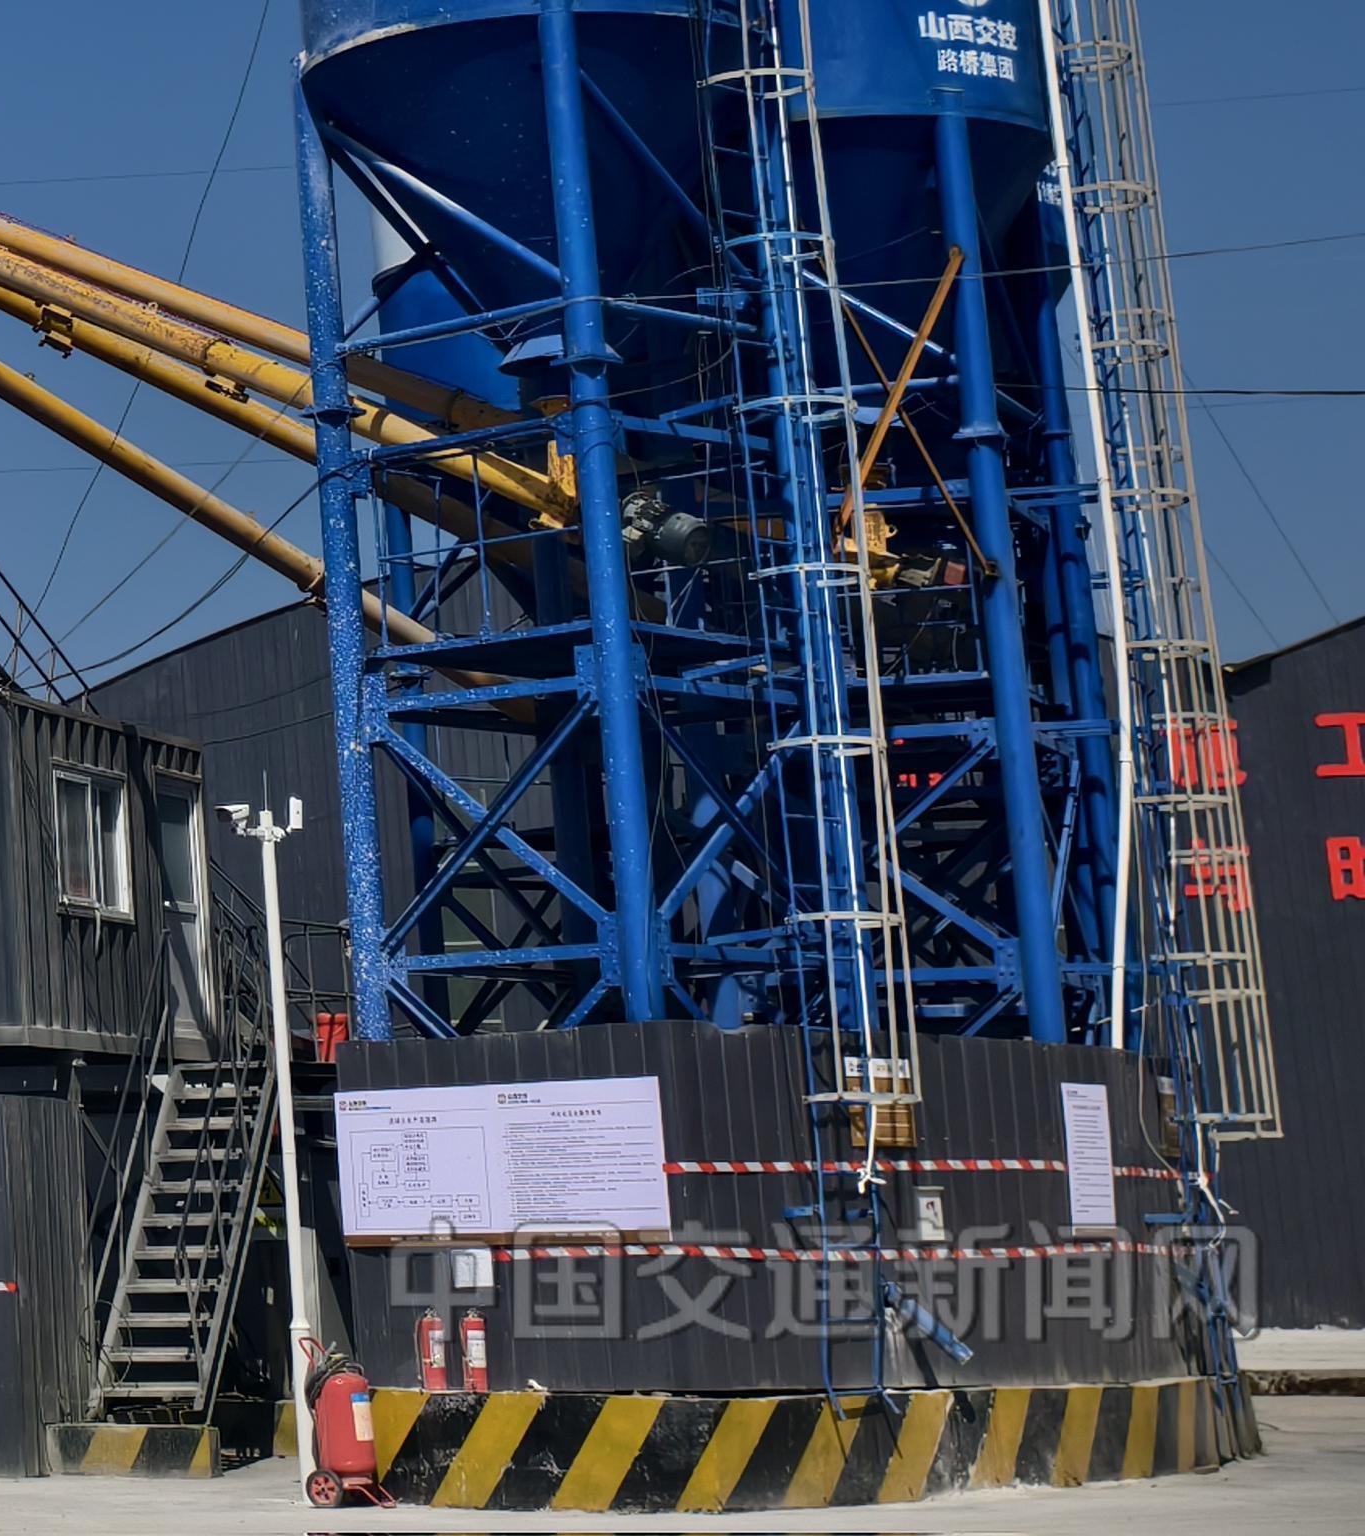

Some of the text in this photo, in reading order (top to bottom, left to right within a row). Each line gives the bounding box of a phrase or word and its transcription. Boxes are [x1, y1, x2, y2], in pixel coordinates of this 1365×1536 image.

[918, 11, 1018, 51] 山西交控
[937, 48, 1018, 82] 路桥集团
